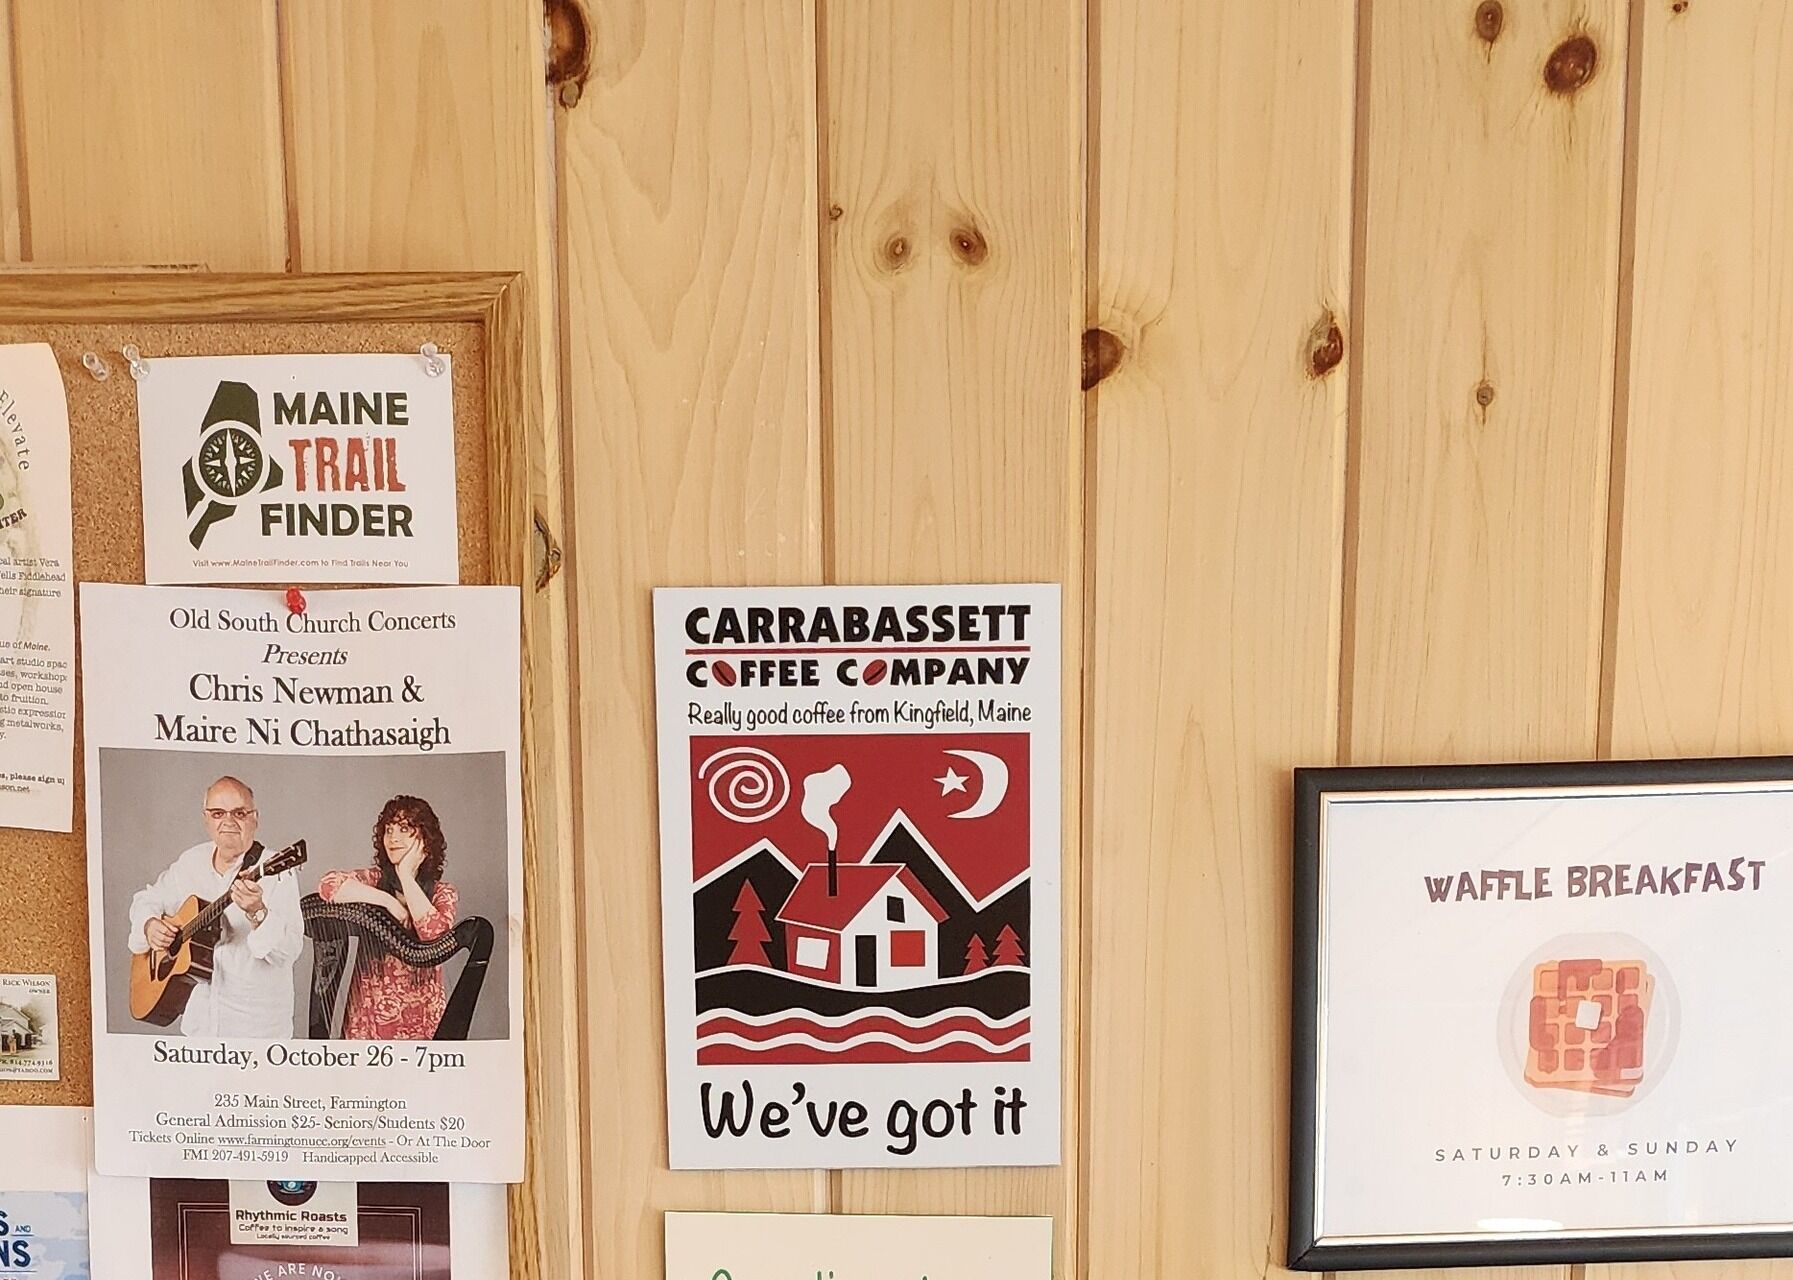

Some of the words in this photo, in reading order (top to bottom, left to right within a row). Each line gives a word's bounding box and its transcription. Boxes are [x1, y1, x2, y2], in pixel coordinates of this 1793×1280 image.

[273, 392, 409, 425] MAINE
[288, 437, 406, 491] TRAIL
[260, 504, 413, 537] FINDER
[18, 572, 66, 582] Fiddlehead
[19, 588, 62, 597] signature
[169, 608, 210, 630] Old
[218, 610, 279, 632] South
[286, 613, 361, 633] Church
[368, 611, 456, 631] Concerts
[685, 605, 1031, 644] CARRABASSETT
[261, 644, 348, 665] Presents
[190, 674, 263, 702] Chris
[273, 676, 393, 704] Newman
[401, 675, 424, 702] &
[689, 702, 741, 730] Really
[747, 703, 787, 731] good
[792, 701, 845, 724] coffee
[850, 701, 889, 723] from
[894, 700, 974, 729] Kingfield,
[979, 700, 1031, 722] Maine
[155, 714, 236, 744] Maire
[246, 717, 281, 745] Ni
[290, 717, 451, 750] Chathasaigh
[1424, 867, 1552, 902] WAFFLE
[1567, 856, 1765, 898] BREAKFAST
[154, 1041, 258, 1069] Saturday,
[266, 1044, 359, 1067] October
[367, 1045, 394, 1067] 26
[415, 1046, 466, 1072] 7pm
[214, 1094, 239, 1108] 235
[244, 1094, 279, 1108] Main
[283, 1095, 326, 1110] Street,
[330, 1096, 407, 1112] Farmington
[156, 1112, 210, 1126] General
[215, 1114, 287, 1128] Admission
[291, 1115, 321, 1130] $25-
[324, 1116, 435, 1130] Seniors/Students
[440, 1116, 465, 1130] $20
[700, 1080, 868, 1139] We've
[886, 1088, 977, 1155] got
[994, 1086, 1026, 1136] it
[129, 1130, 172, 1143] Tickets
[175, 1132, 214, 1144] Online
[396, 1136, 413, 1146] Or
[416, 1136, 430, 1147] At
[433, 1136, 457, 1148] The
[461, 1137, 491, 1148] Door
[183, 1149, 208, 1160] FMI
[212, 1150, 288, 1162] 207-491-5919
[303, 1152, 376, 1164] Handicapped
[380, 1152, 439, 1164] Accessible
[1435, 1145, 1579, 1162] SATURDAY
[1597, 1144, 1608, 1156] &
[1628, 1140, 1737, 1155] SUNDAY
[1502, 1170, 1667, 1186] 7:30AM-11AM
[236, 1210, 296, 1222] Rhythmic
[301, 1211, 347, 1222] Roasts
[15, 1225, 31, 1233] AND
[284, 1225, 315, 1233] inspire
[326, 1226, 348, 1234] song
[277, 1263, 305, 1277] ARE
